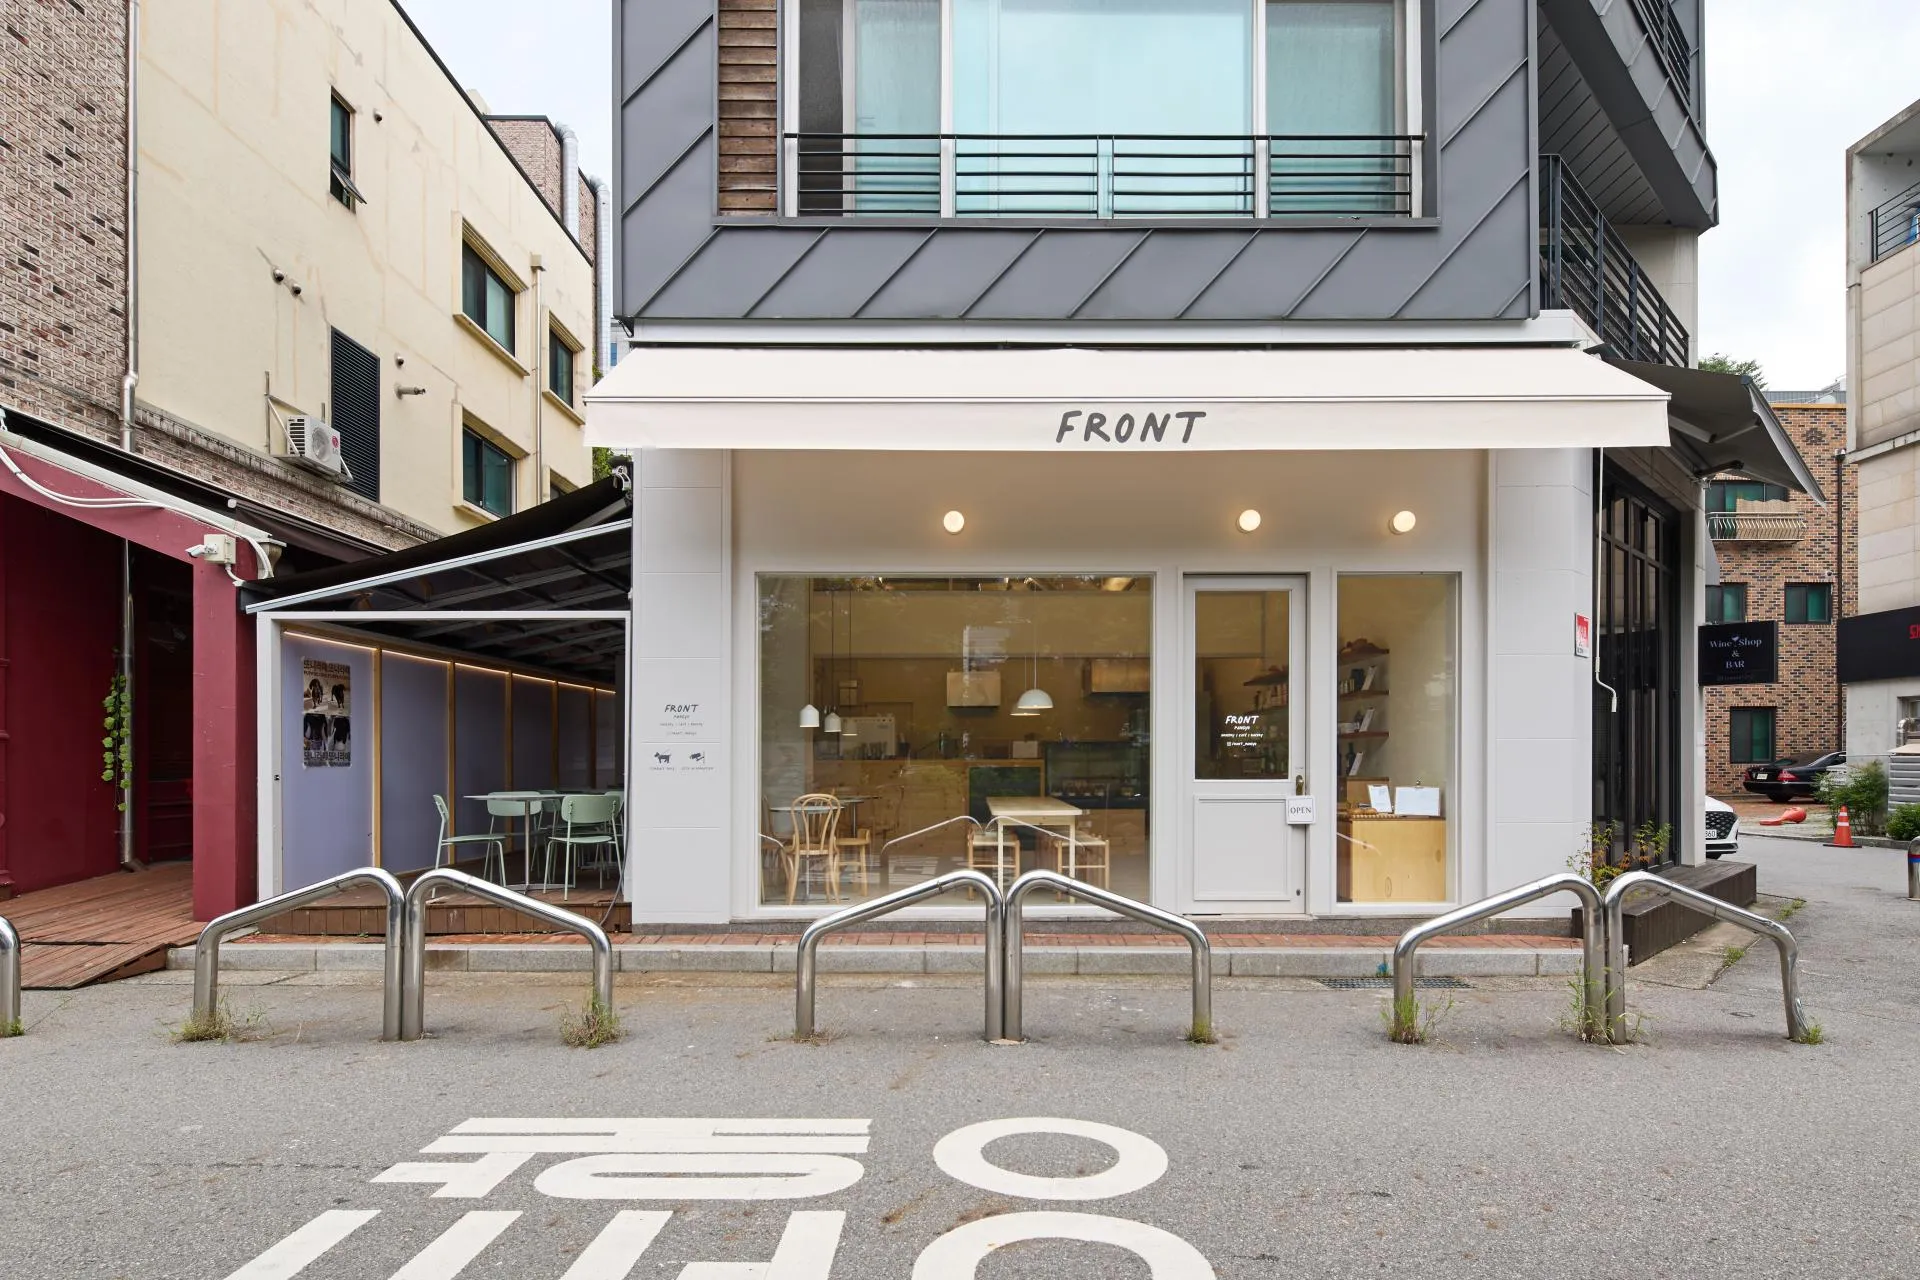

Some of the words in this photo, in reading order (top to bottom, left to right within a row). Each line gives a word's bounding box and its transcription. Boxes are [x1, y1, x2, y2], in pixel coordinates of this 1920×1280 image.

[1055, 410, 1207, 443] FRONT
[1709, 640, 1732, 648] Wine
[1738, 638, 1762, 648] Shop
[1731, 650, 1740, 658] &
[1725, 660, 1745, 669] BAR
[664, 704, 698, 712] FRONT
[1225, 715, 1259, 724] FRONT
